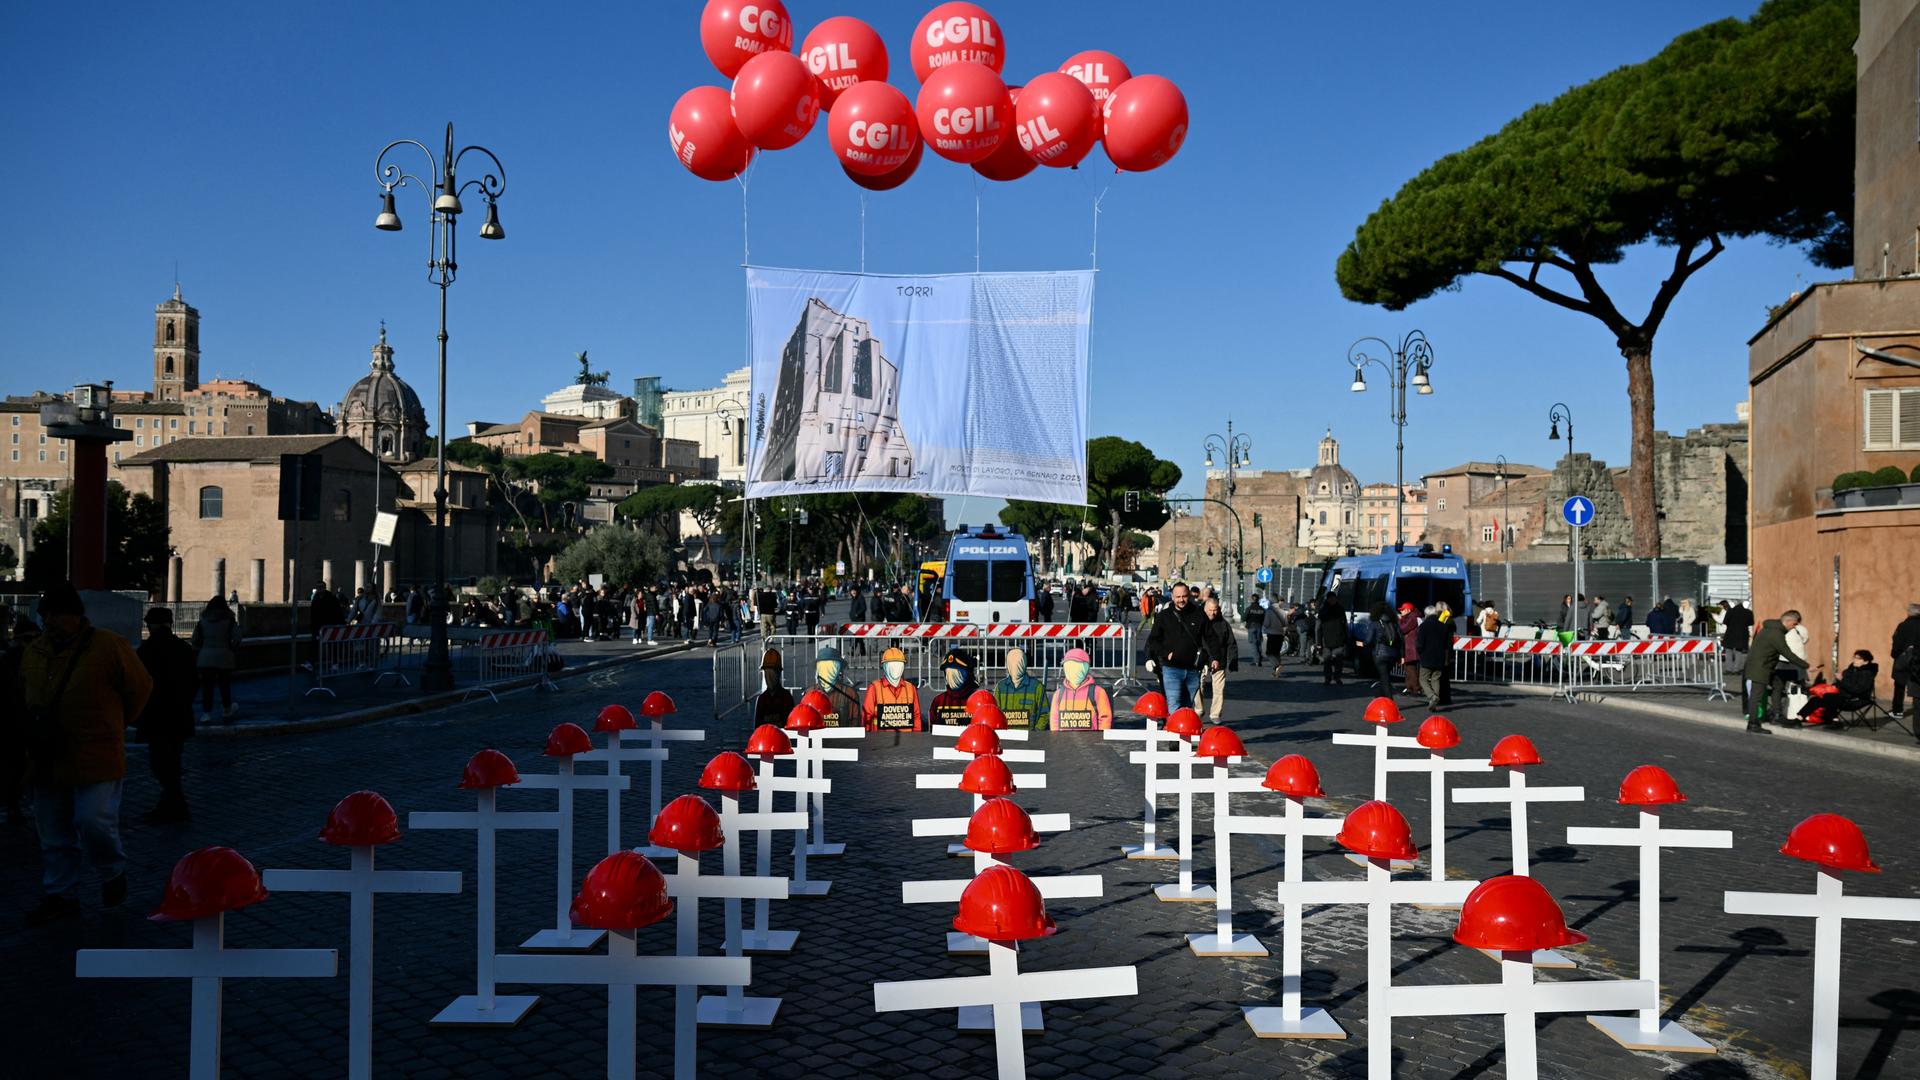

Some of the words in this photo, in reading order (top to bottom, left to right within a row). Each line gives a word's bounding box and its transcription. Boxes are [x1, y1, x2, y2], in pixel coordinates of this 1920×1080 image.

[926, 16, 996, 47] CGIL
[929, 50, 958, 67] ROMA
[961, 50, 967, 63] E
[970, 50, 995, 65] LAZIO
[1061, 63, 1109, 84] GIL
[933, 105, 1000, 135] CGIL
[848, 120, 910, 149] CGIL
[1016, 115, 1061, 151] GIL
[936, 138, 963, 150] ROMA
[846, 147, 874, 164] ROMA
[896, 286, 933, 297] TORRI
[959, 546, 1018, 554] POLIZIA
[1401, 565, 1458, 574] POLIZIA
[883, 705, 909, 713] DOVEVO
[1060, 712, 1090, 720] LAVORAVO
[1060, 720, 1069, 728] DA
[1070, 720, 1077, 728] 10
[1078, 720, 1090, 728] ORE
